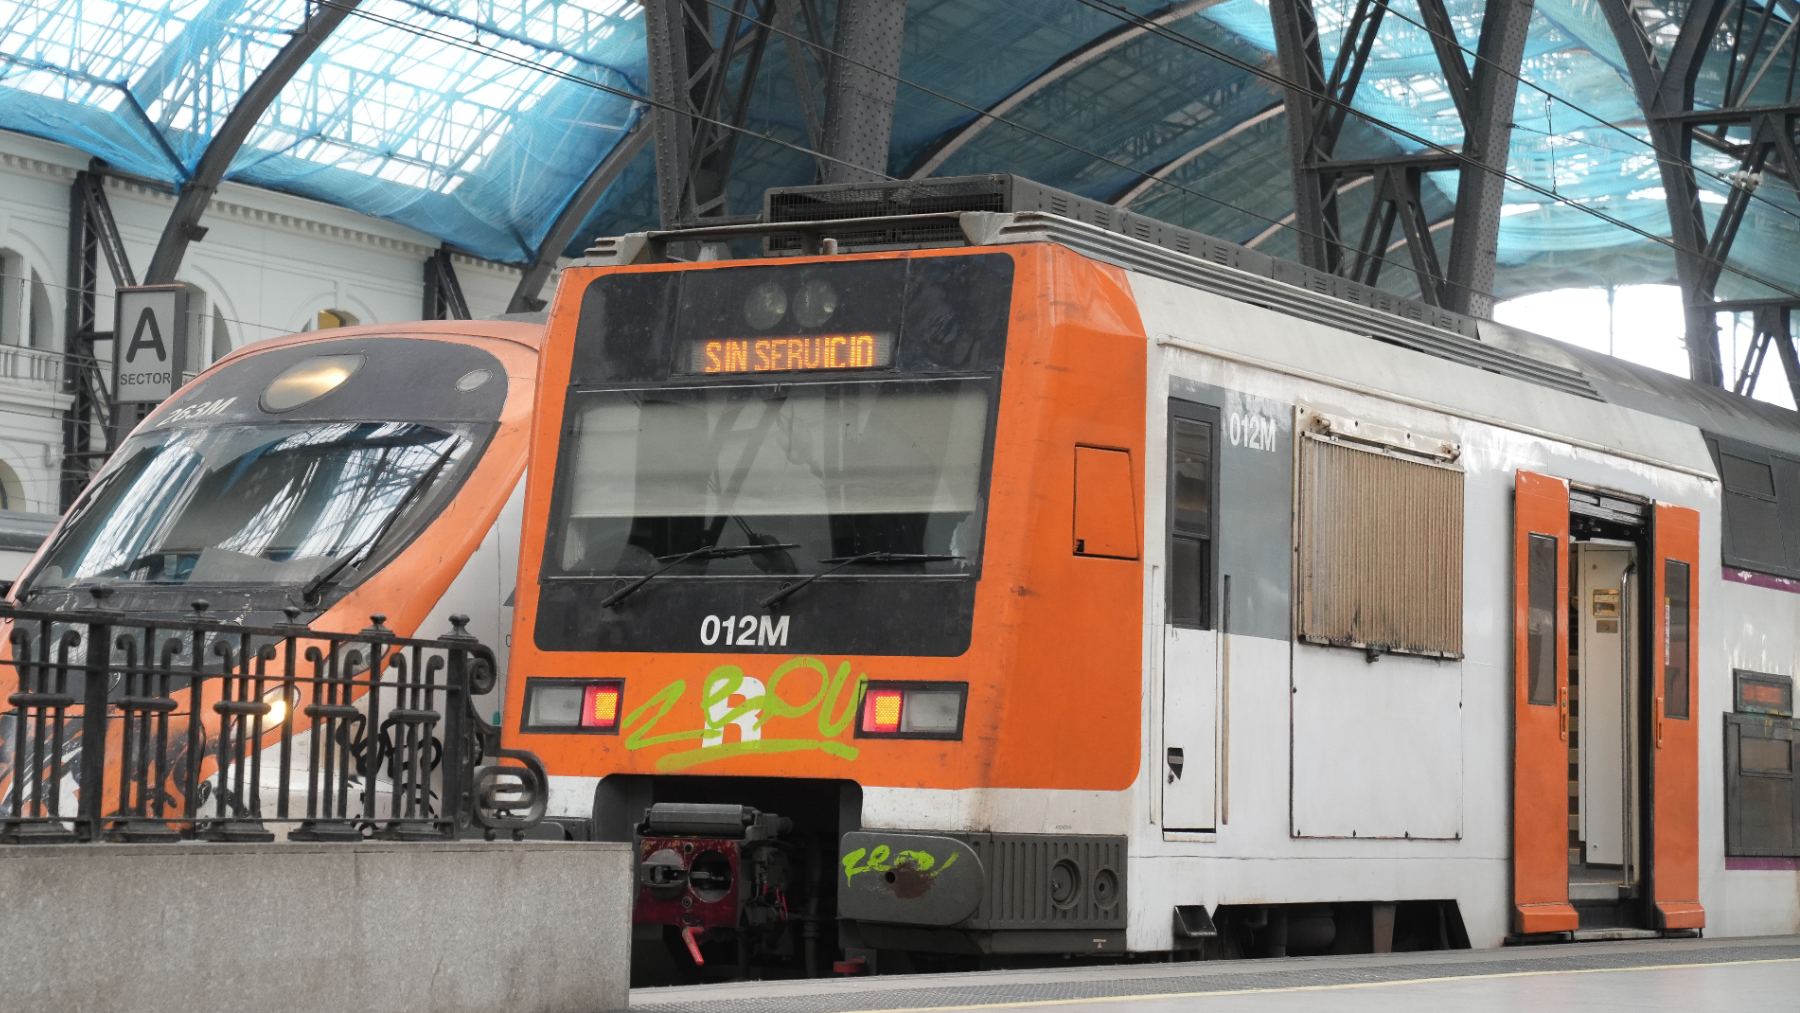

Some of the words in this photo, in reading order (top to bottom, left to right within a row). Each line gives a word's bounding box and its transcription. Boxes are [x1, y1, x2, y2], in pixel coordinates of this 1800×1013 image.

[126, 307, 166, 363] A
[704, 341, 748, 373] SIN
[120, 373, 171, 385] SECTOR
[155, 396, 238, 428] 263M
[1229, 411, 1276, 453] 012M
[700, 614, 790, 646] 012M
